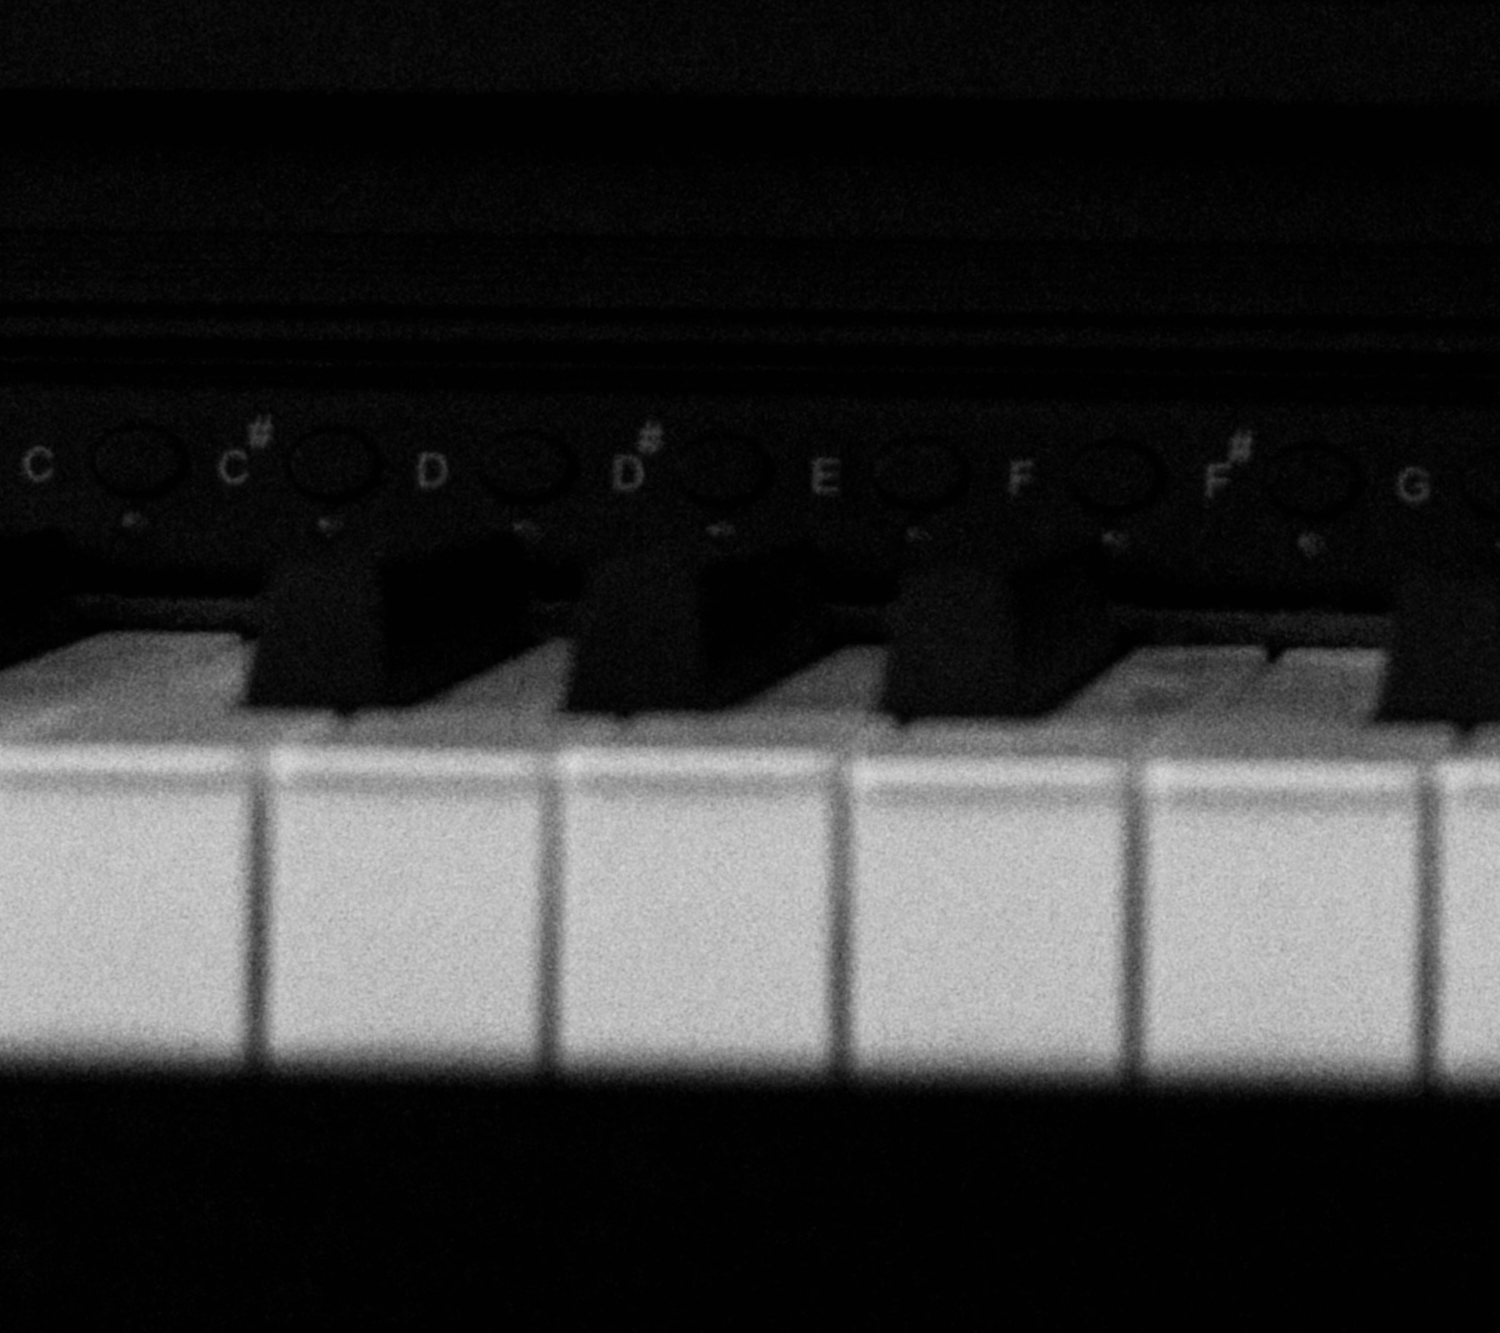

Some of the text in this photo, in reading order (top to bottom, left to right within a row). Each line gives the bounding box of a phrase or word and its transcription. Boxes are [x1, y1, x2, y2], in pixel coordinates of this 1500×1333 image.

[21, 445, 55, 483] C
[416, 451, 449, 490] D
[811, 457, 840, 494] E
[1008, 460, 1034, 495] F
[1397, 466, 1431, 503] G
